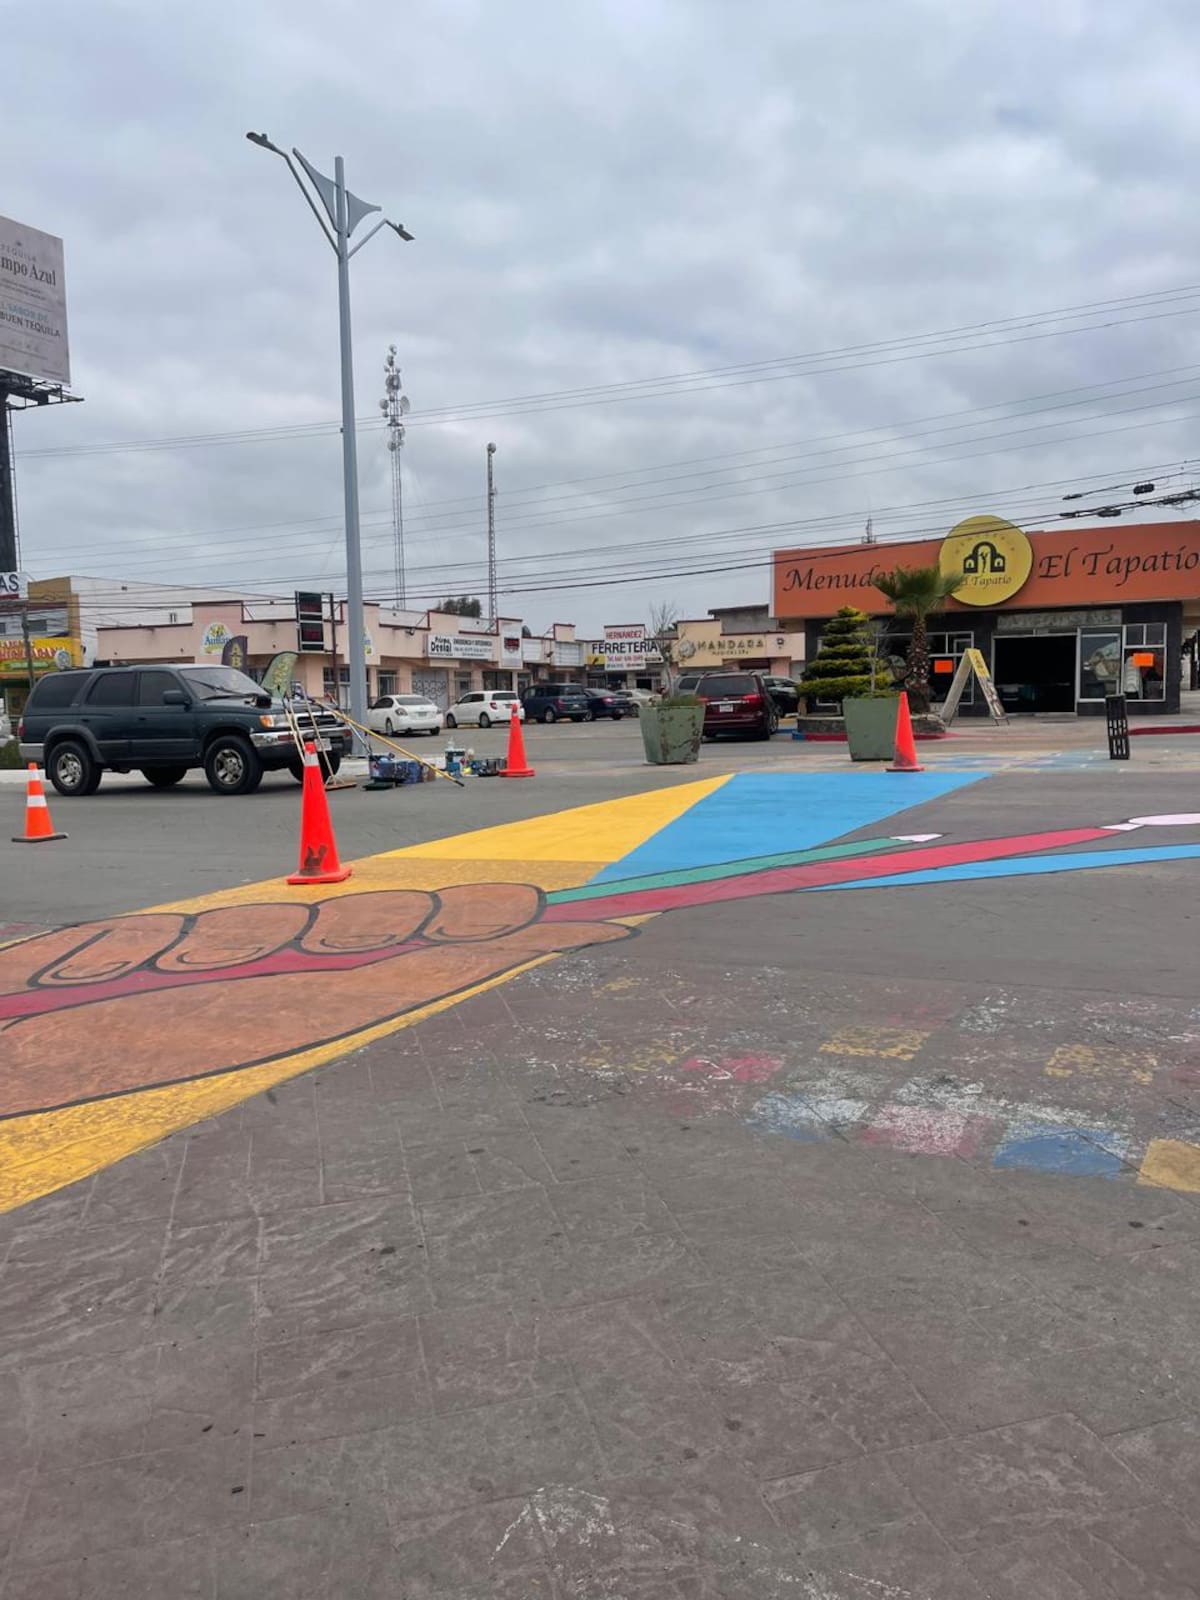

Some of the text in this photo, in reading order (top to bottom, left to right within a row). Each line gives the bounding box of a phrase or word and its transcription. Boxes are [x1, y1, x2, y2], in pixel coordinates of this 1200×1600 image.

[29, 264, 56, 287] Azul
[24, 319, 60, 338] TEQUILA
[1039, 544, 1200, 587] El Tapatío
[0, 573, 19, 592] AS
[431, 641, 452, 652] Dental
[592, 641, 658, 654] FERRETERIA
